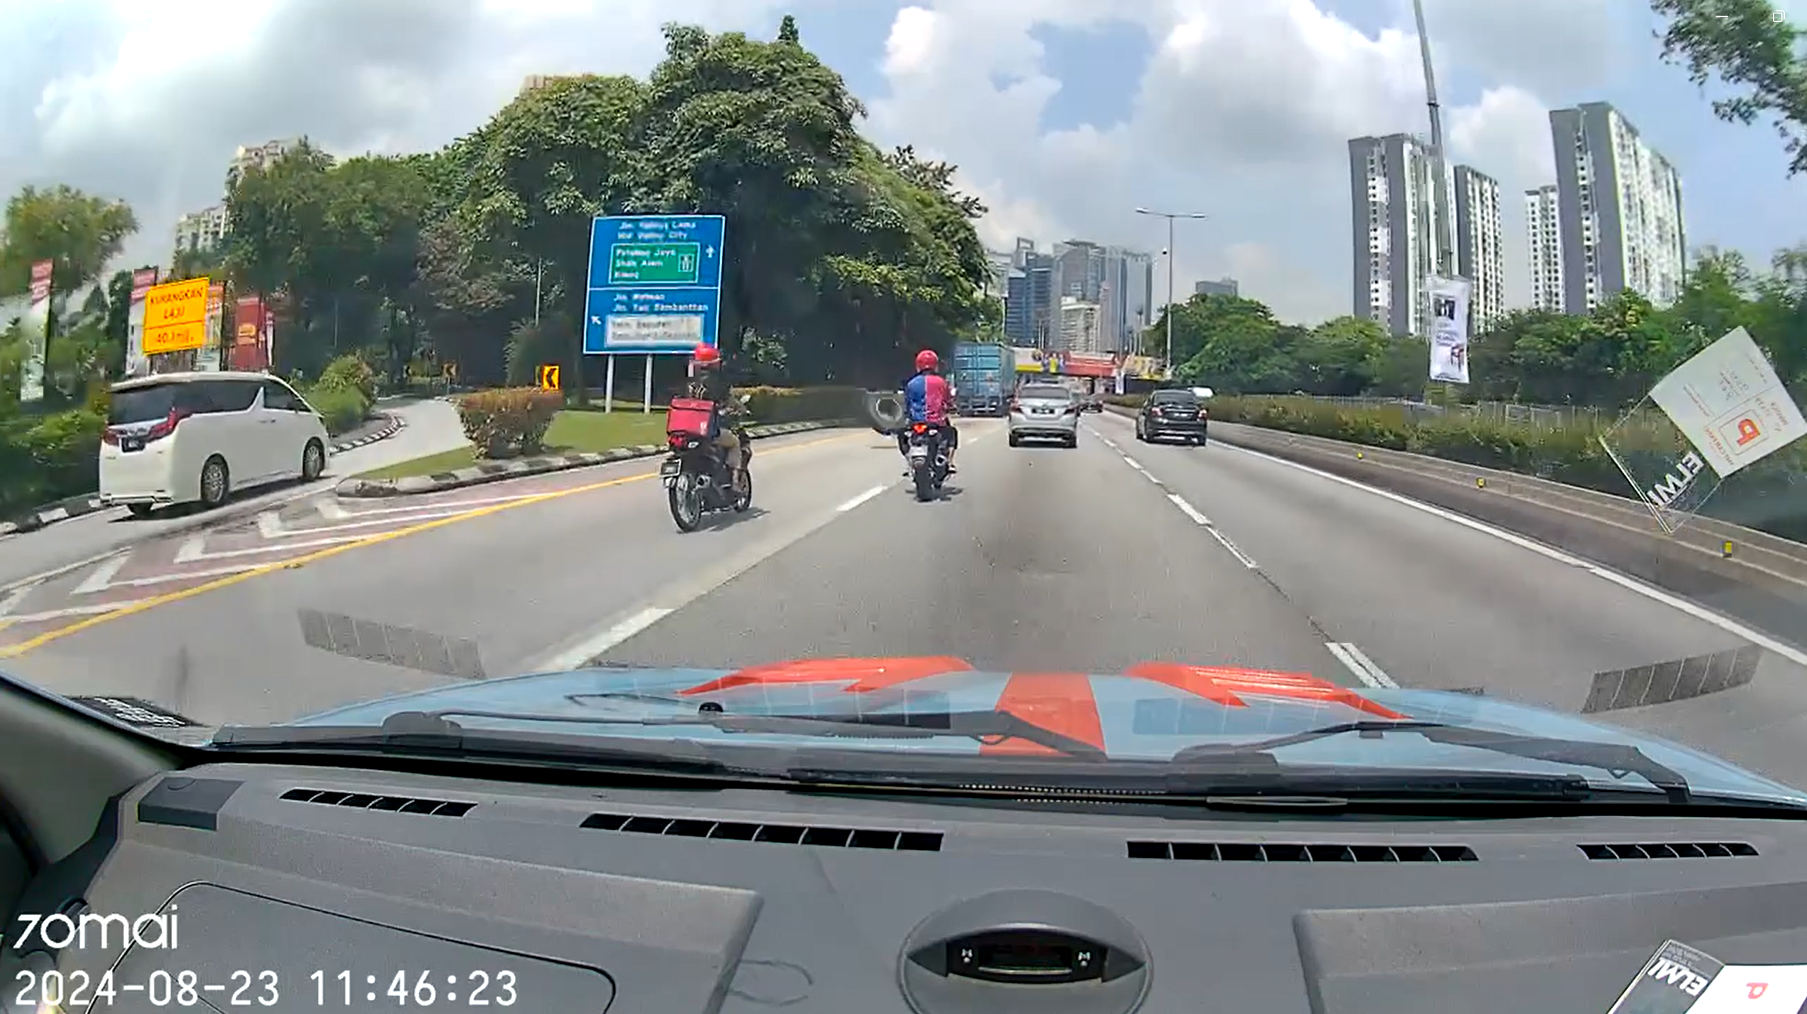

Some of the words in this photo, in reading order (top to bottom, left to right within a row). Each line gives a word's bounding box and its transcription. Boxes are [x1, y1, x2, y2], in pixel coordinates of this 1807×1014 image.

[150, 286, 204, 305] KURANGKAN
[163, 305, 185, 320] LAJU
[1648, 958, 1709, 996] ELMI
